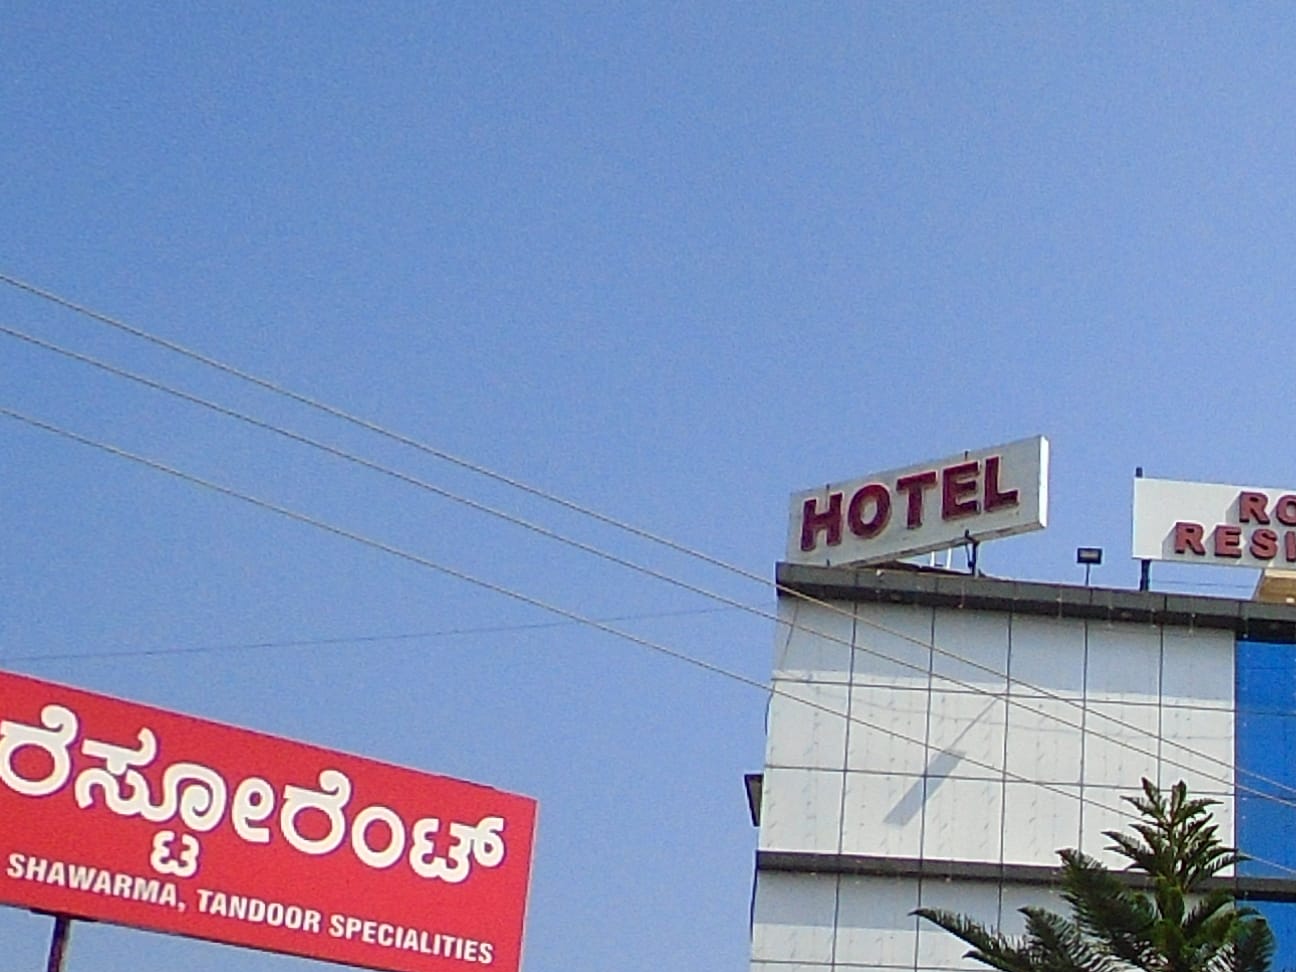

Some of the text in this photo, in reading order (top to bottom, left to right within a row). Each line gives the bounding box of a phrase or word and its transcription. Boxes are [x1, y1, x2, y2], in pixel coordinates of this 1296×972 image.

[800, 456, 1019, 551] HOTEL
[7, 852, 495, 966] SHAWARMA, TANDOOR SPECIALITIES
